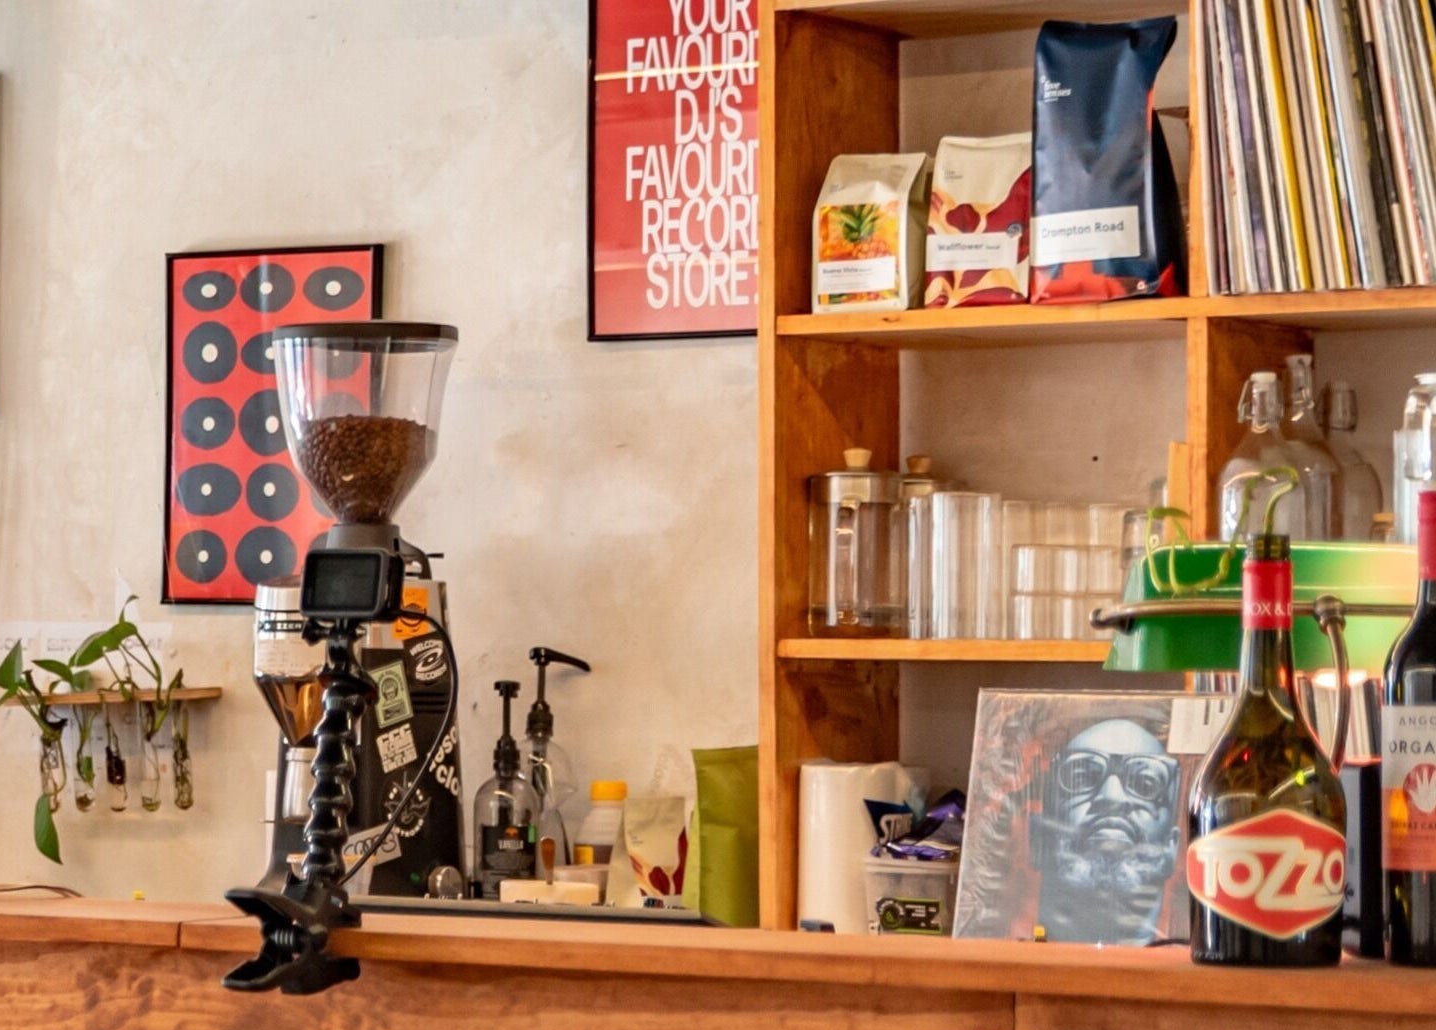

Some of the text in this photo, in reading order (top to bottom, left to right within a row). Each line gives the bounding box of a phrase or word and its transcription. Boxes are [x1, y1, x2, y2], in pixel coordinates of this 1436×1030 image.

[669, 0, 752, 36] YOUR
[626, 30, 759, 94] FAVOURI
[675, 85, 743, 145] DJ'S
[626, 139, 759, 202] FAVOURI
[1041, 221, 1124, 239] Crompton Road
[1195, 836, 1345, 911] TOZZO
